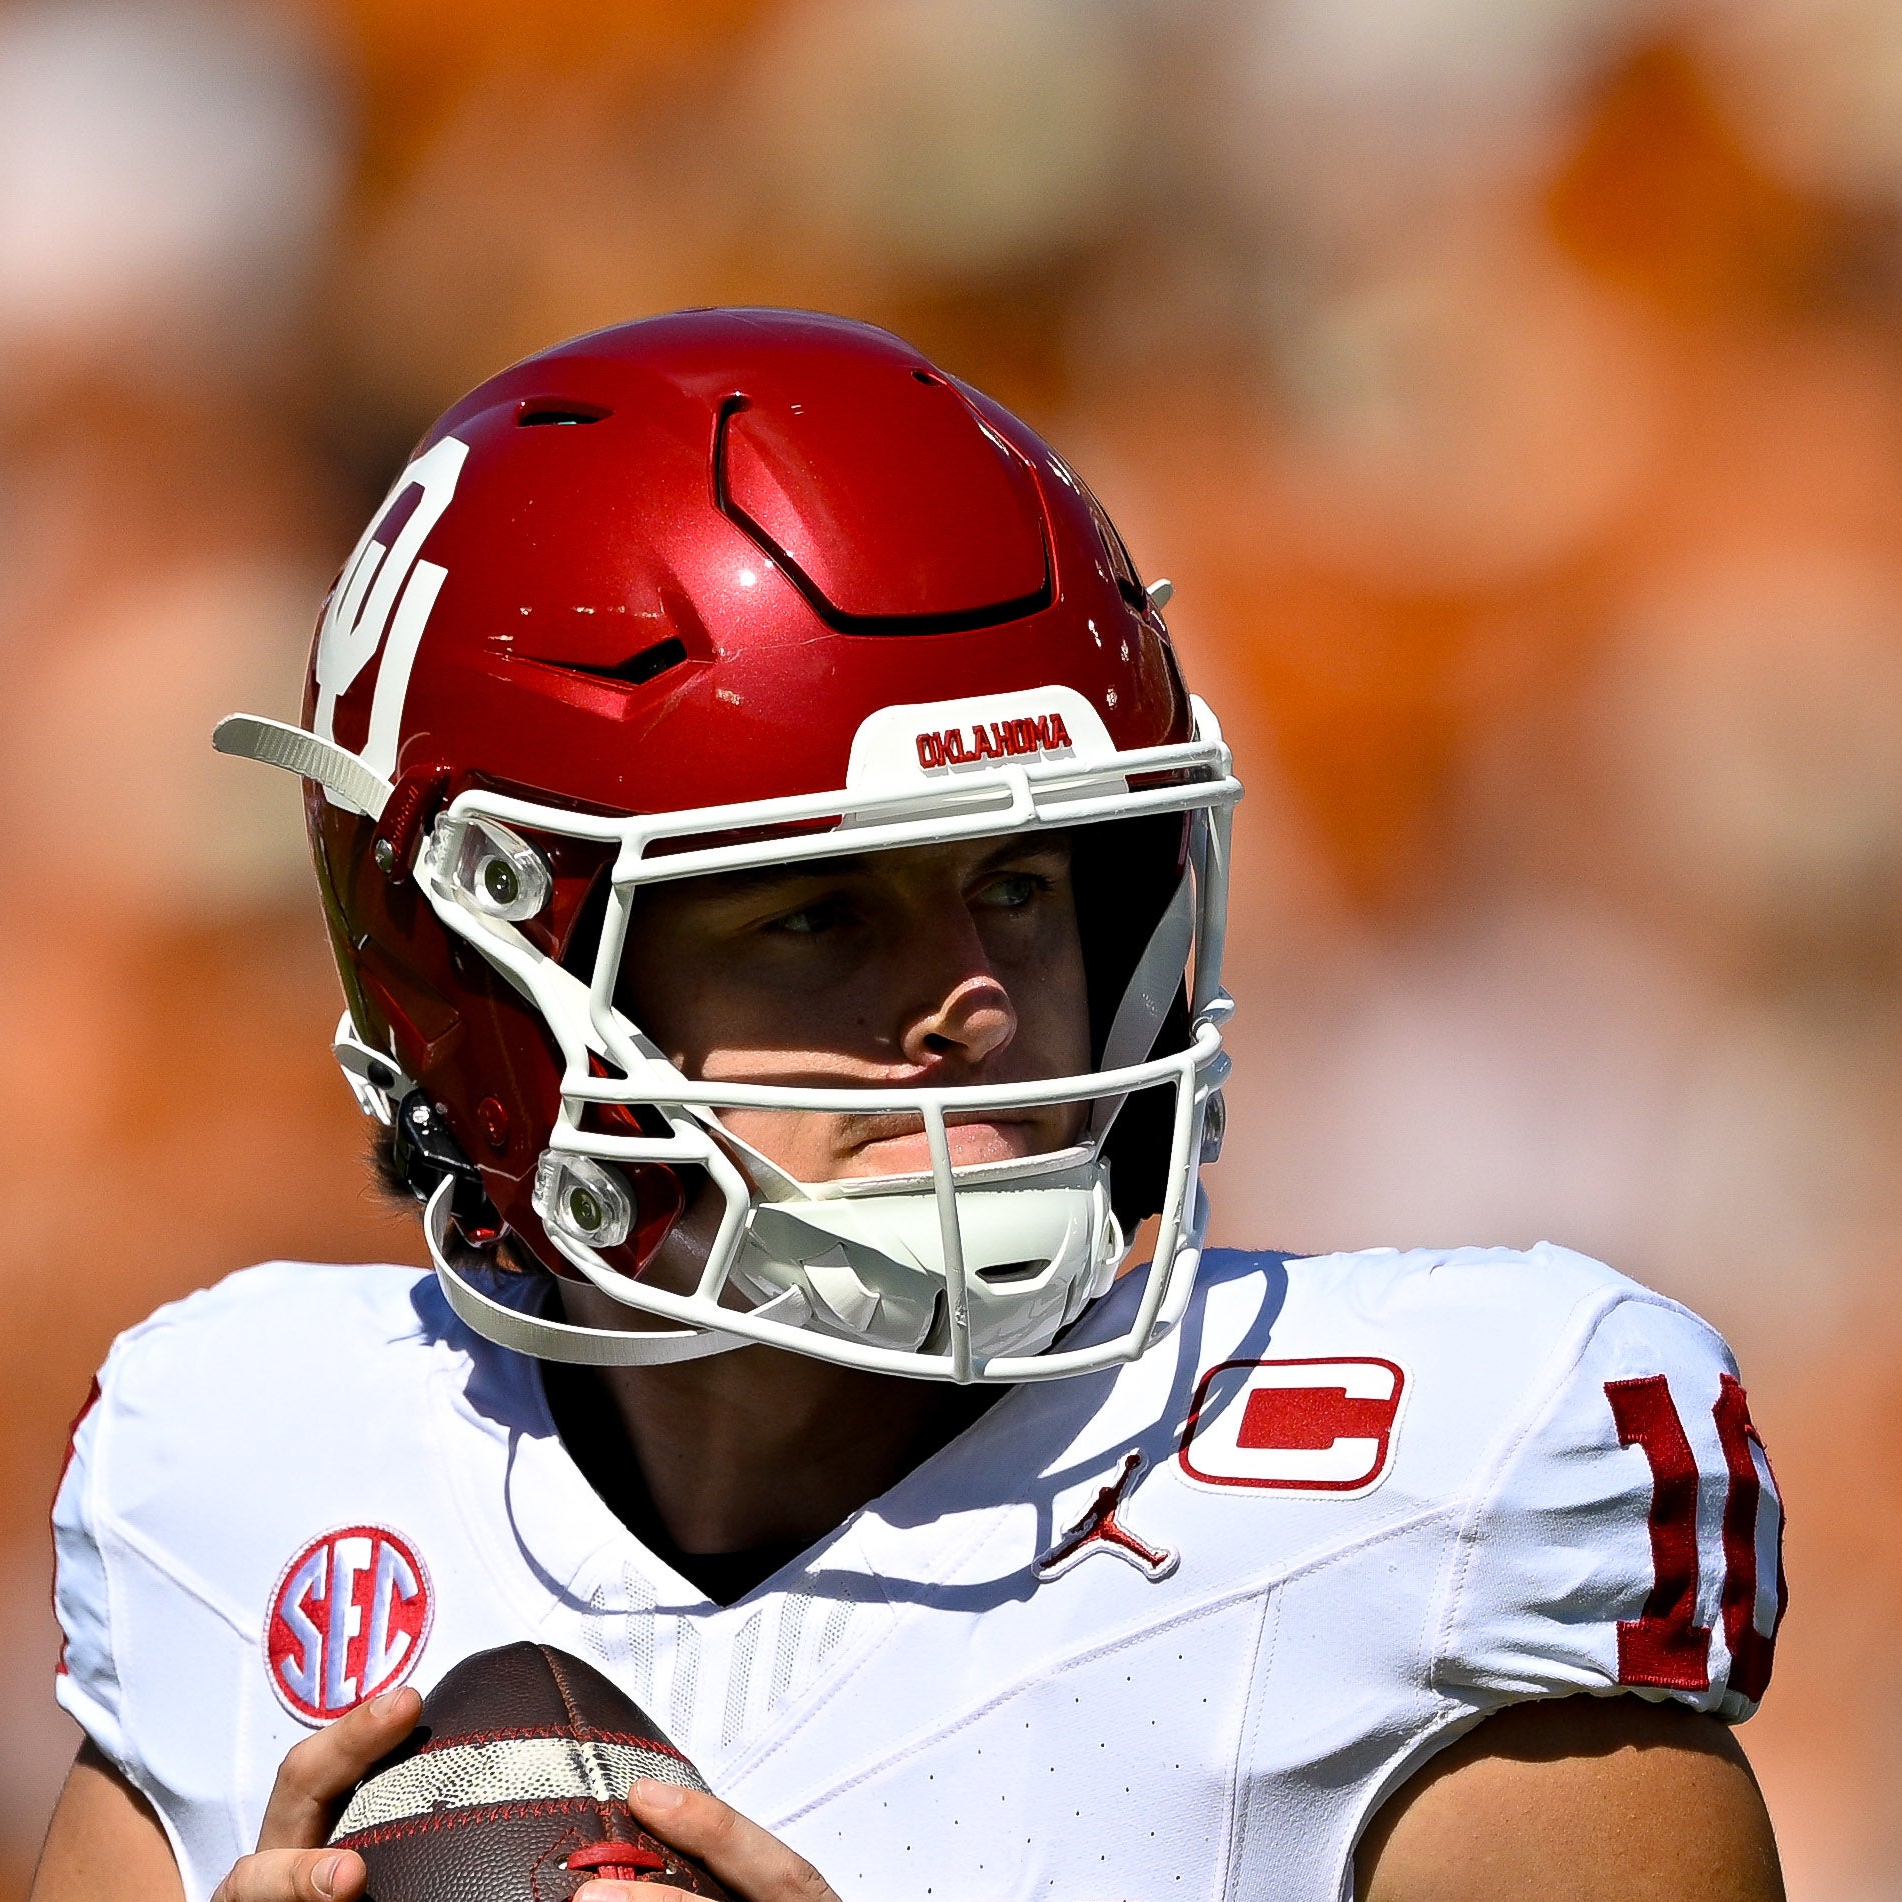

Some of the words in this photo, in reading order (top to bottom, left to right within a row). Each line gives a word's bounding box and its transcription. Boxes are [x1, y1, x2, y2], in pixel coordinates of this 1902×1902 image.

[916, 713, 1073, 769] OKLAHOMA
[1179, 1356, 1405, 1492] C
[1603, 1372, 1789, 1704] 10
[279, 1537, 419, 1710] SEC
